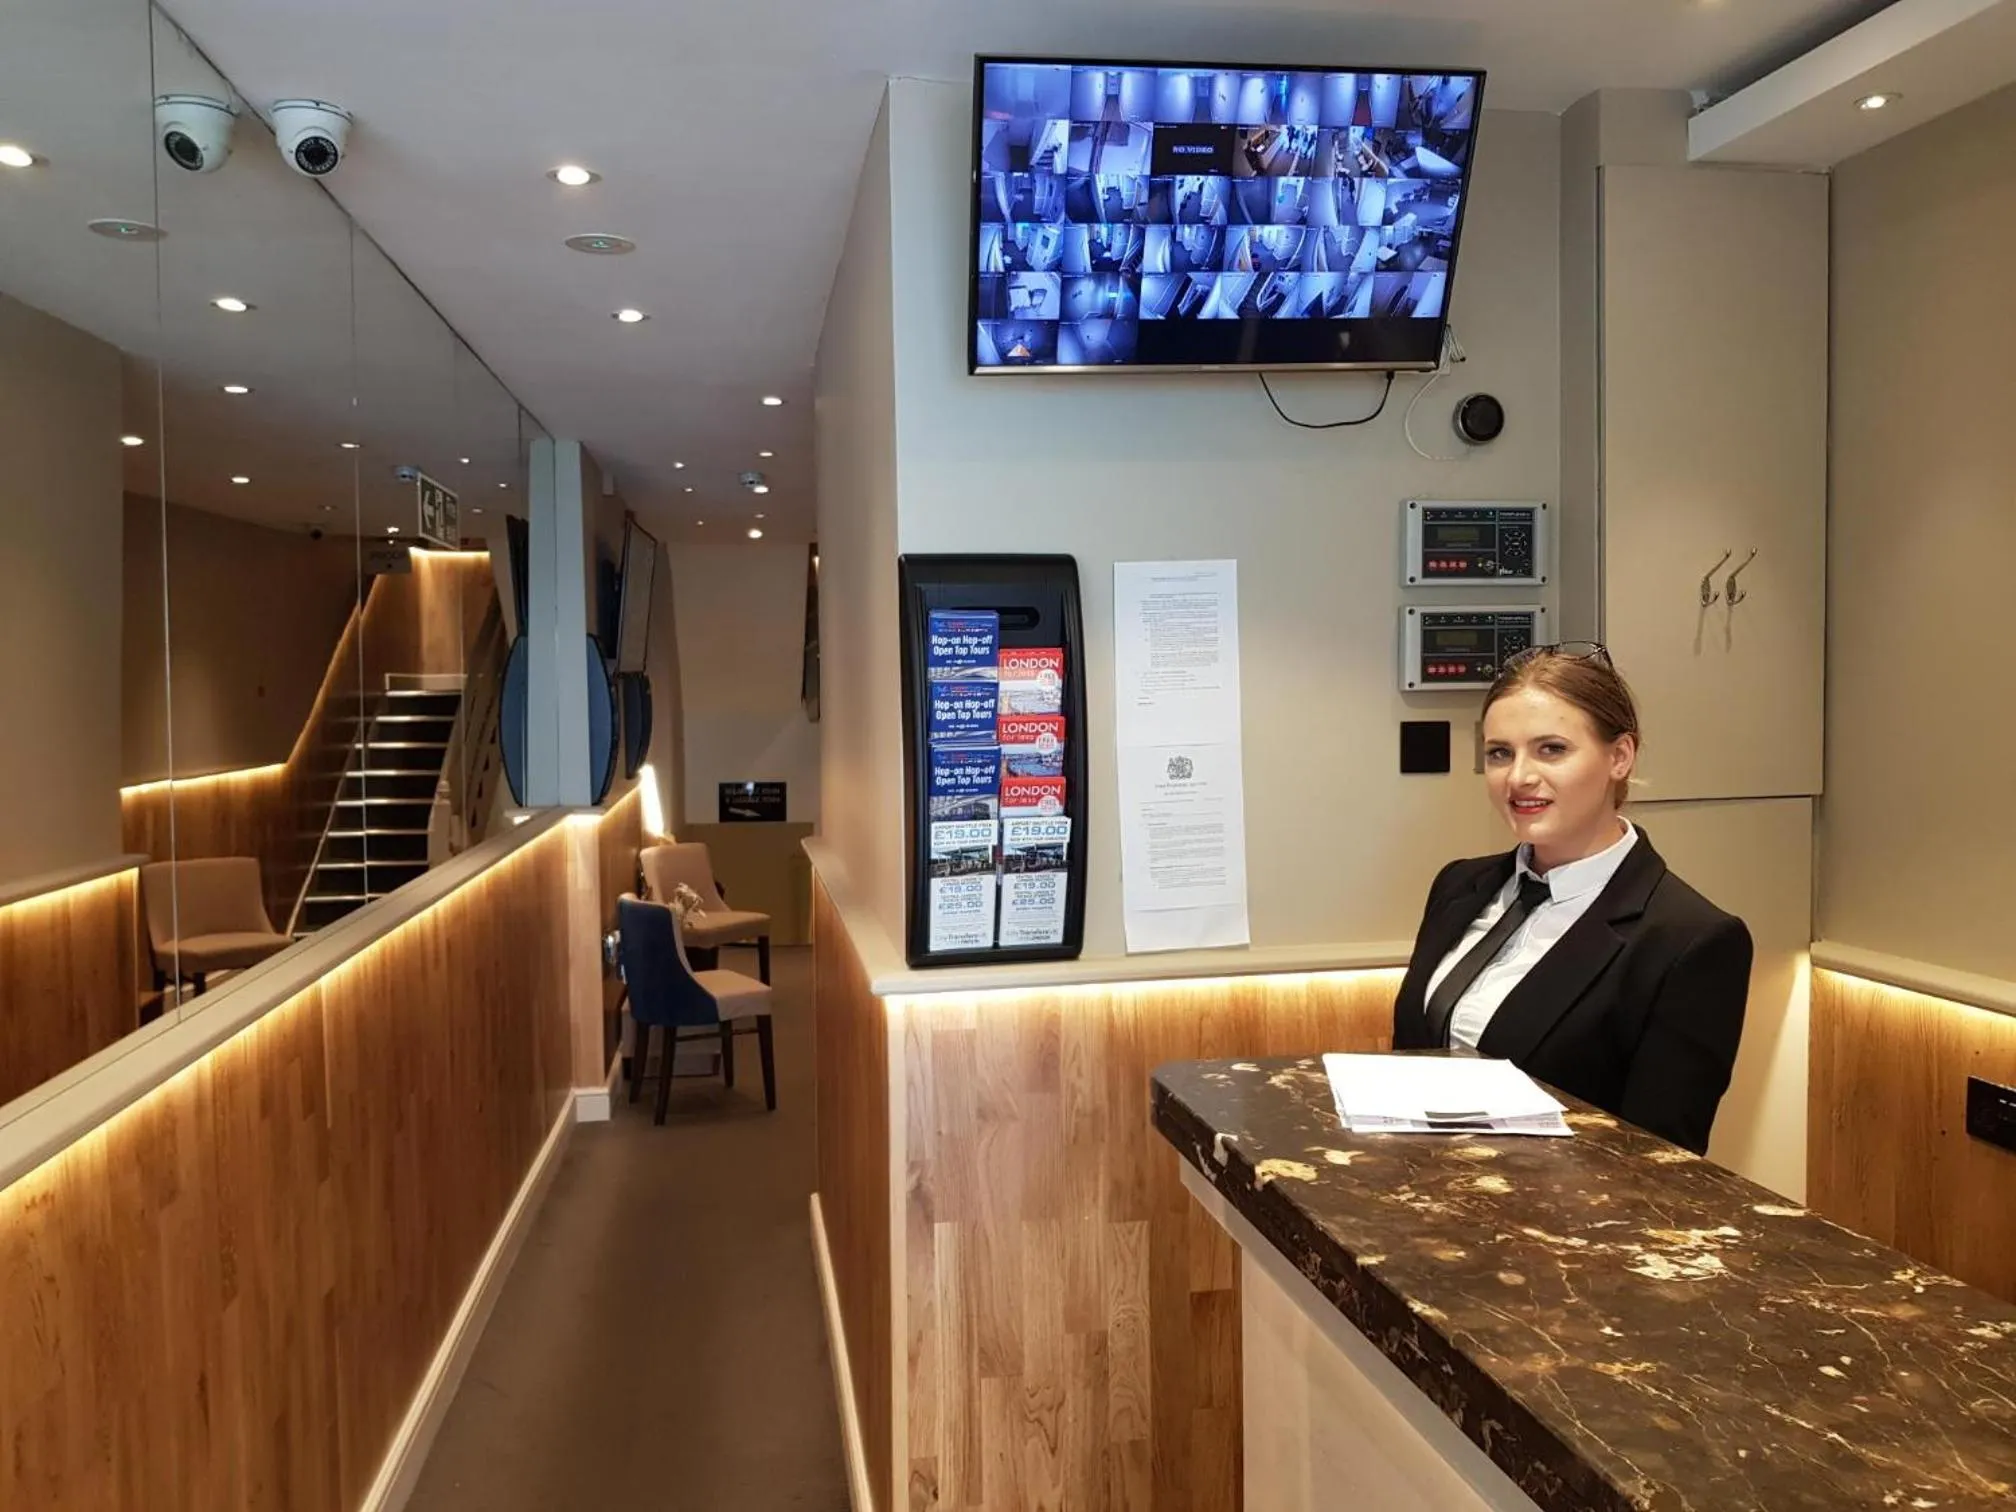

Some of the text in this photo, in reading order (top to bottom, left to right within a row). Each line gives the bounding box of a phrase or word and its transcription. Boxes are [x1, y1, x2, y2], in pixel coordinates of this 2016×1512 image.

[1172, 145, 1214, 154] NO VIDEO
[932, 634, 993, 646] Hop-on Hop-off
[933, 645, 990, 656] Open Top Tours
[1003, 657, 1060, 670] LONDON
[934, 698, 995, 711] Hop-on Hop-off
[936, 710, 992, 721] Open Top Tours
[1002, 721, 1059, 734] LONDON
[934, 765, 995, 777] Hop-on Hop-off
[936, 775, 992, 787] Open Top Tours
[1004, 785, 1061, 797] LONDON
[934, 828, 992, 840] £19.00
[1011, 825, 1068, 836] £19.00
